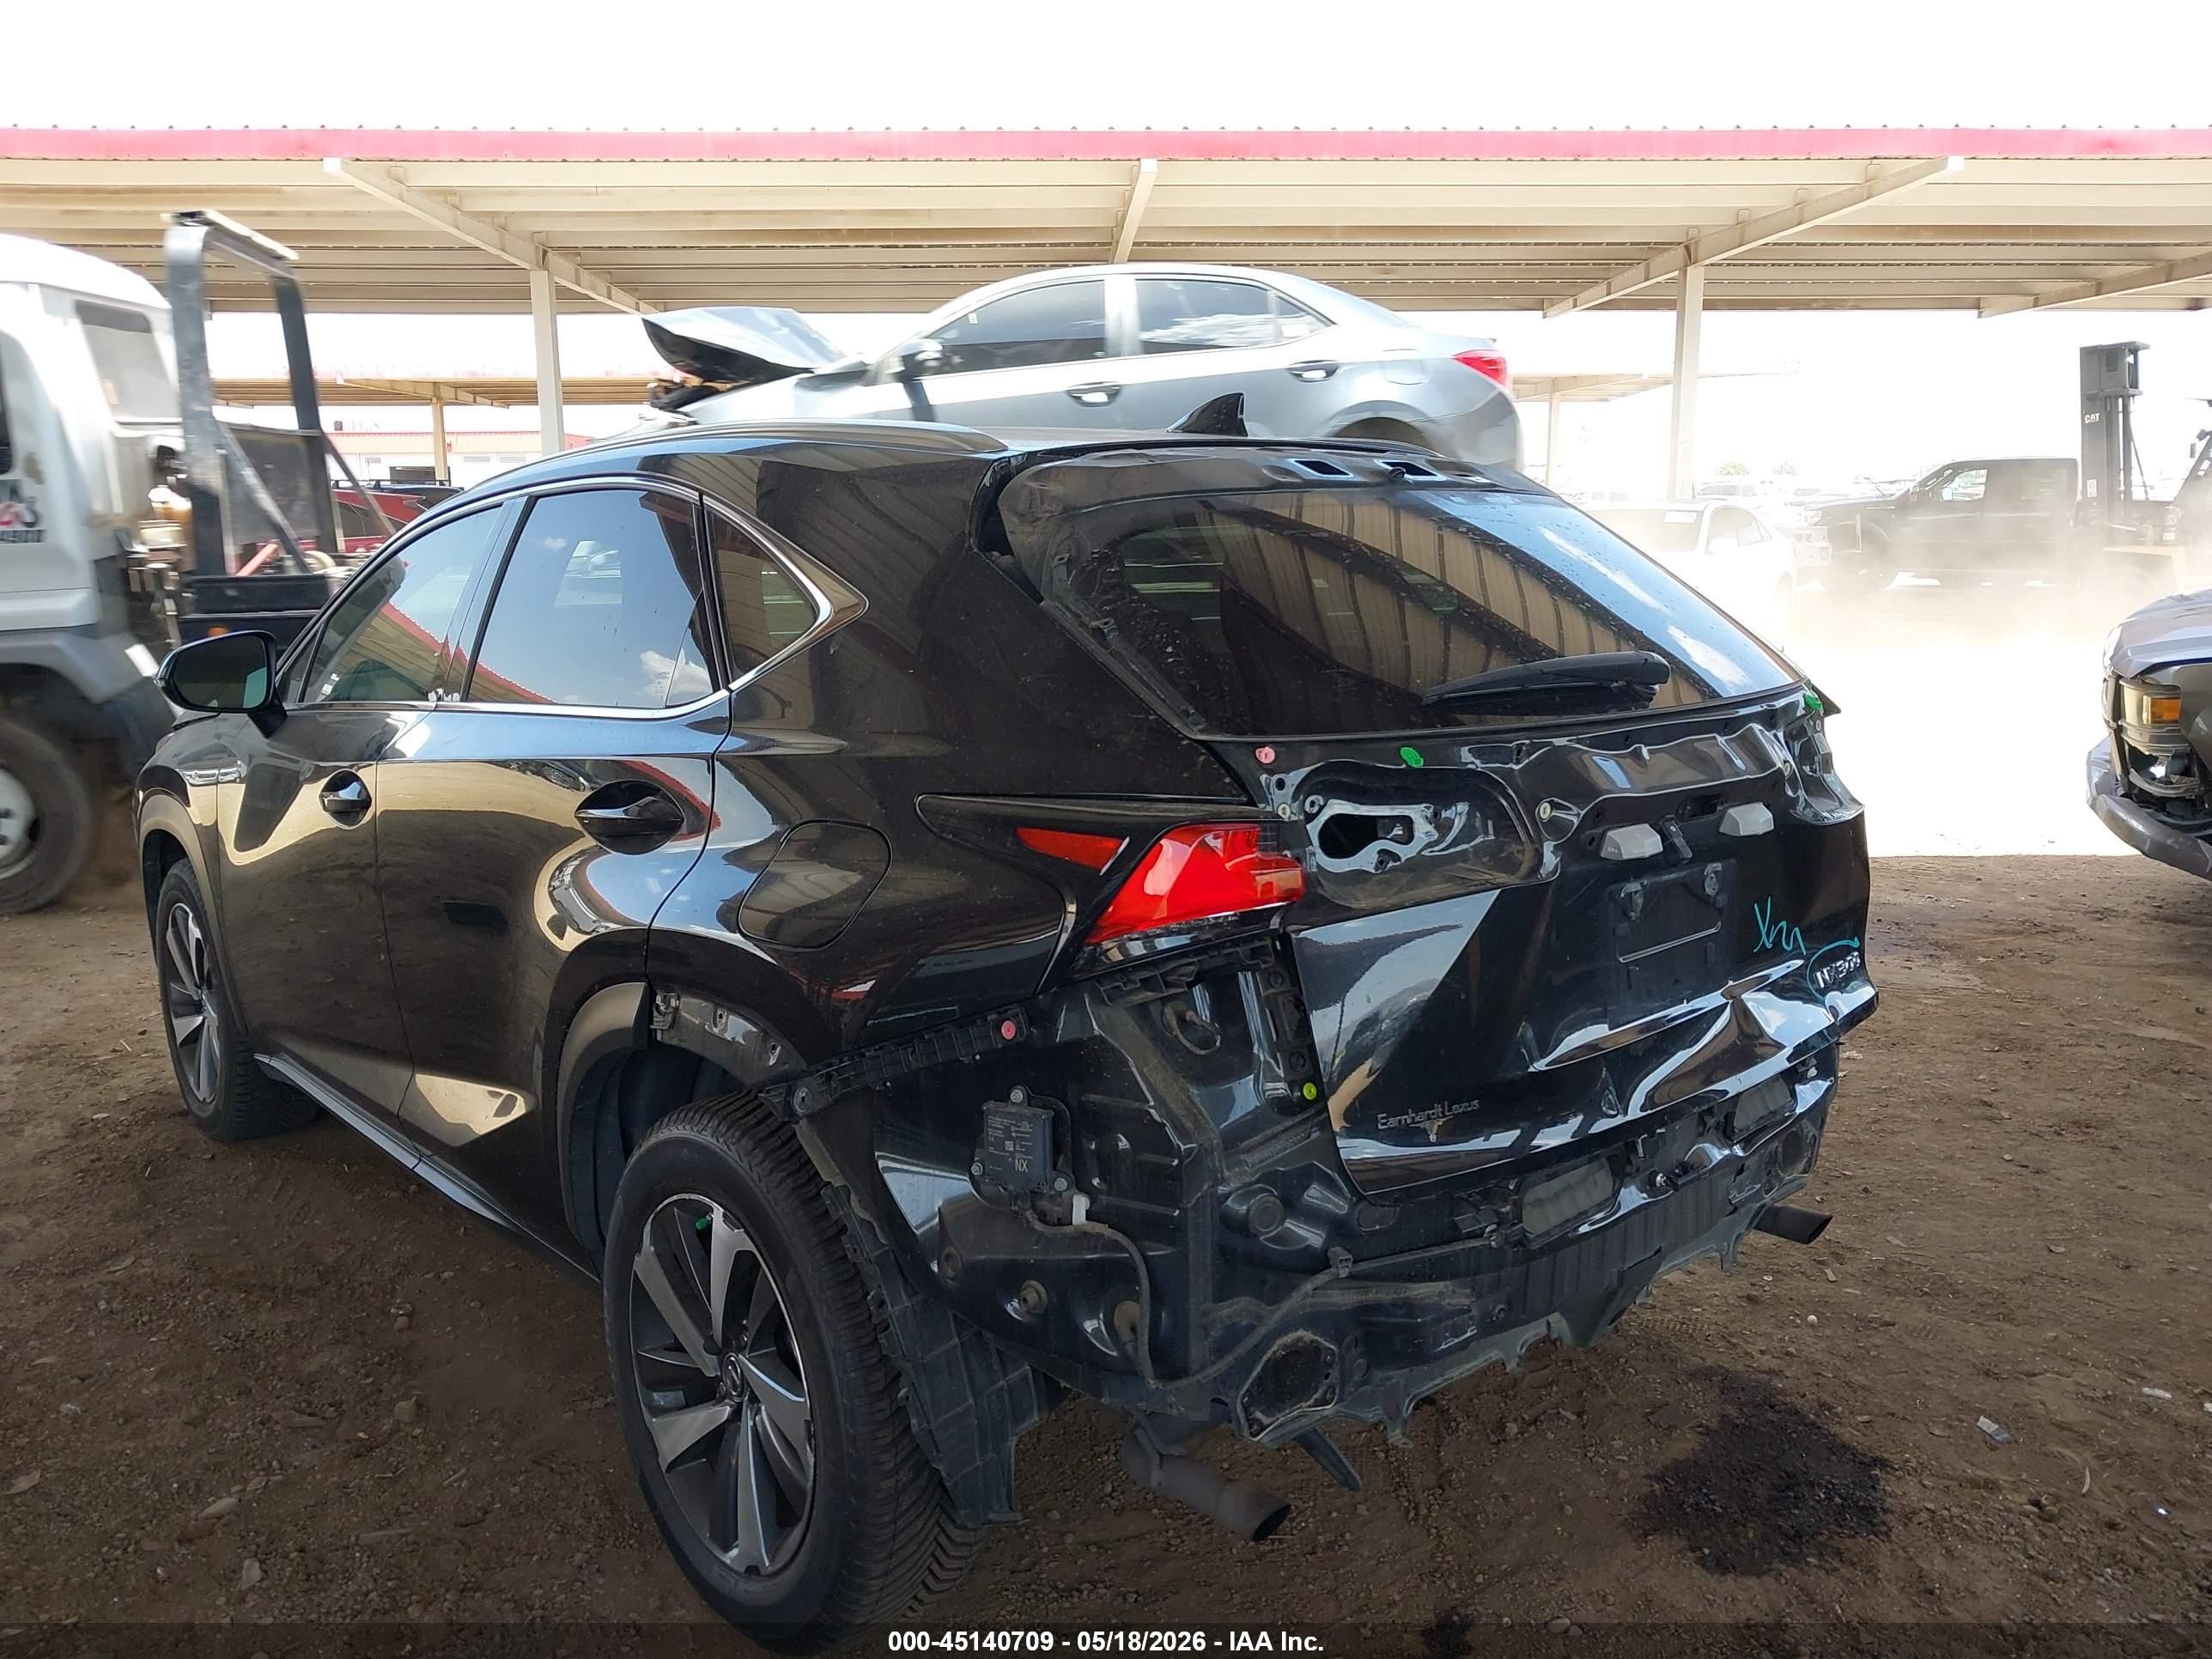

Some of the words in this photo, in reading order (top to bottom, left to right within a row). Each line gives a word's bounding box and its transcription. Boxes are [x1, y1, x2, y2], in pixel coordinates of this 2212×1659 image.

[2085, 412, 2100, 424] CAT
[1377, 1103, 1443, 1130] Earnhardt
[1444, 1099, 1480, 1115] Lexus
[1015, 1158, 1029, 1173] NX
